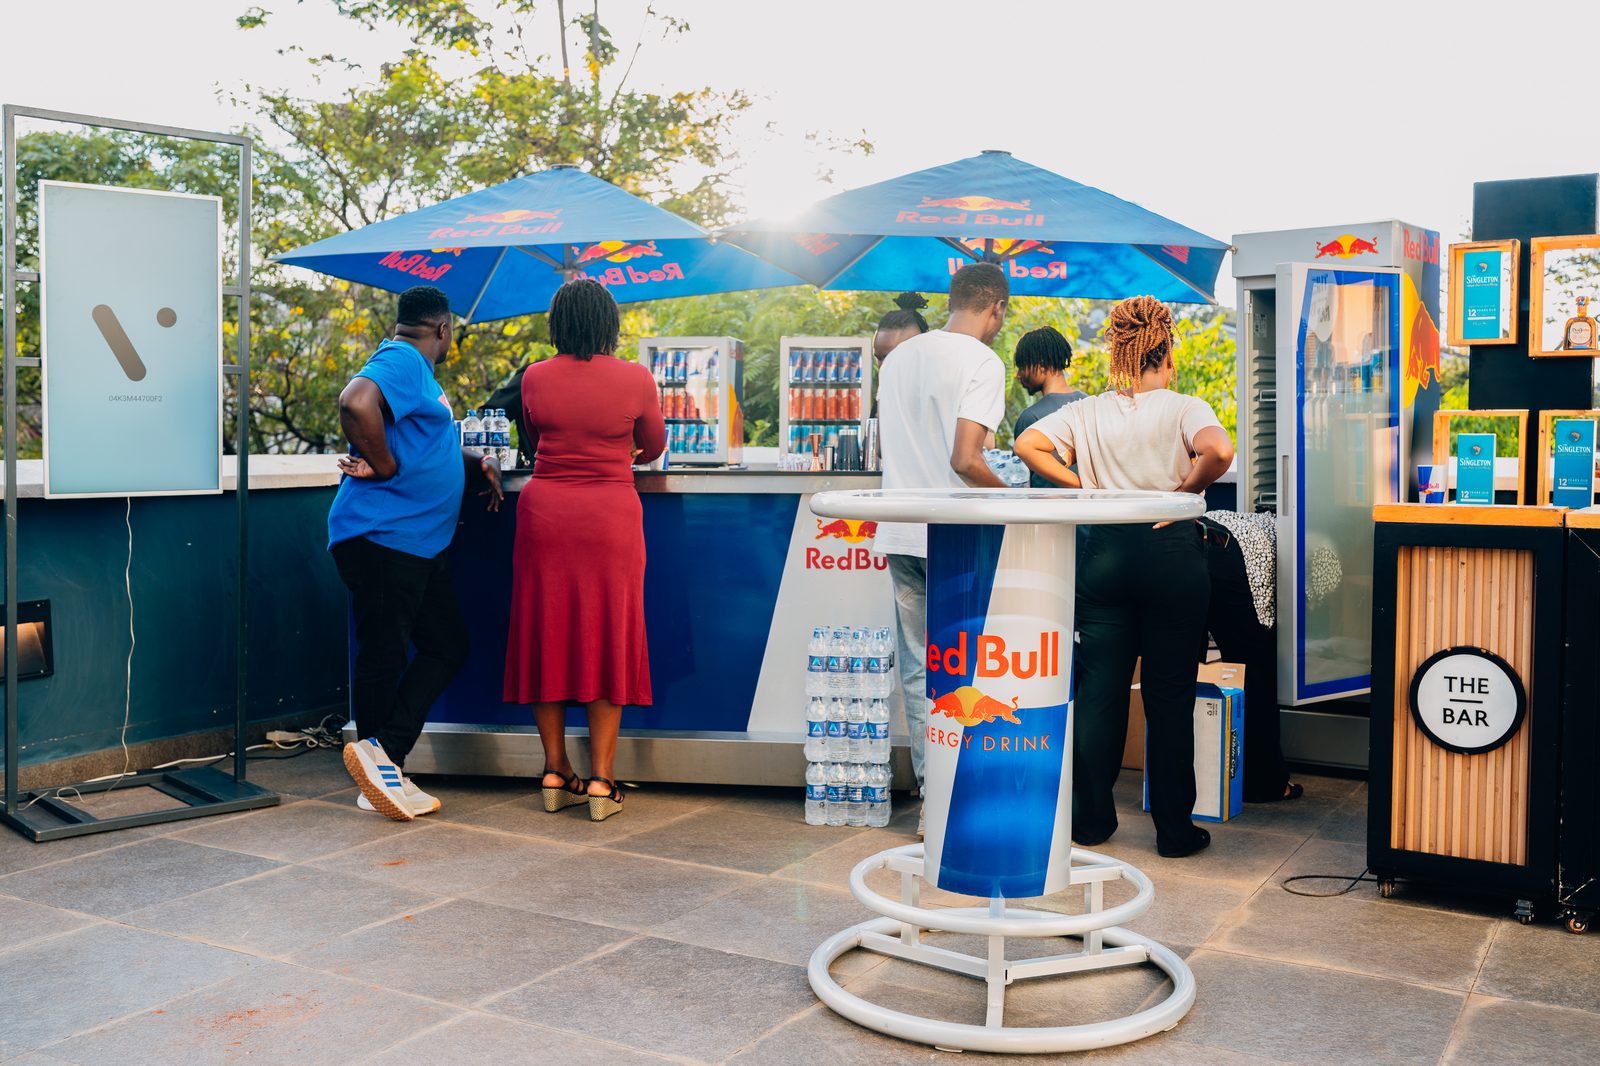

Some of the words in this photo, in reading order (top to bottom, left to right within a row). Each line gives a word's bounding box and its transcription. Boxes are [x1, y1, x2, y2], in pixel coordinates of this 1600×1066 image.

[894, 210, 969, 225] Red
[974, 213, 1046, 227] Bull
[427, 225, 497, 240] Red
[496, 221, 565, 236] Bull
[1403, 228, 1423, 262] Red
[1423, 234, 1439, 265] Bull
[1466, 275, 1498, 285] SINGLETON
[1468, 308, 1477, 317] 12
[1557, 444, 1591, 453] SINGLETON
[1460, 457, 1491, 467] SINGLETON
[1558, 478, 1568, 486] 12
[1461, 490, 1469, 498] 12
[855, 548, 888, 571] Bu
[926, 628, 968, 676] ed
[976, 631, 1059, 680] Bull
[1443, 675, 1490, 695] THE
[1442, 707, 1490, 728] BAR
[925, 725, 974, 750] NERGY
[983, 735, 1051, 752] DRINK
